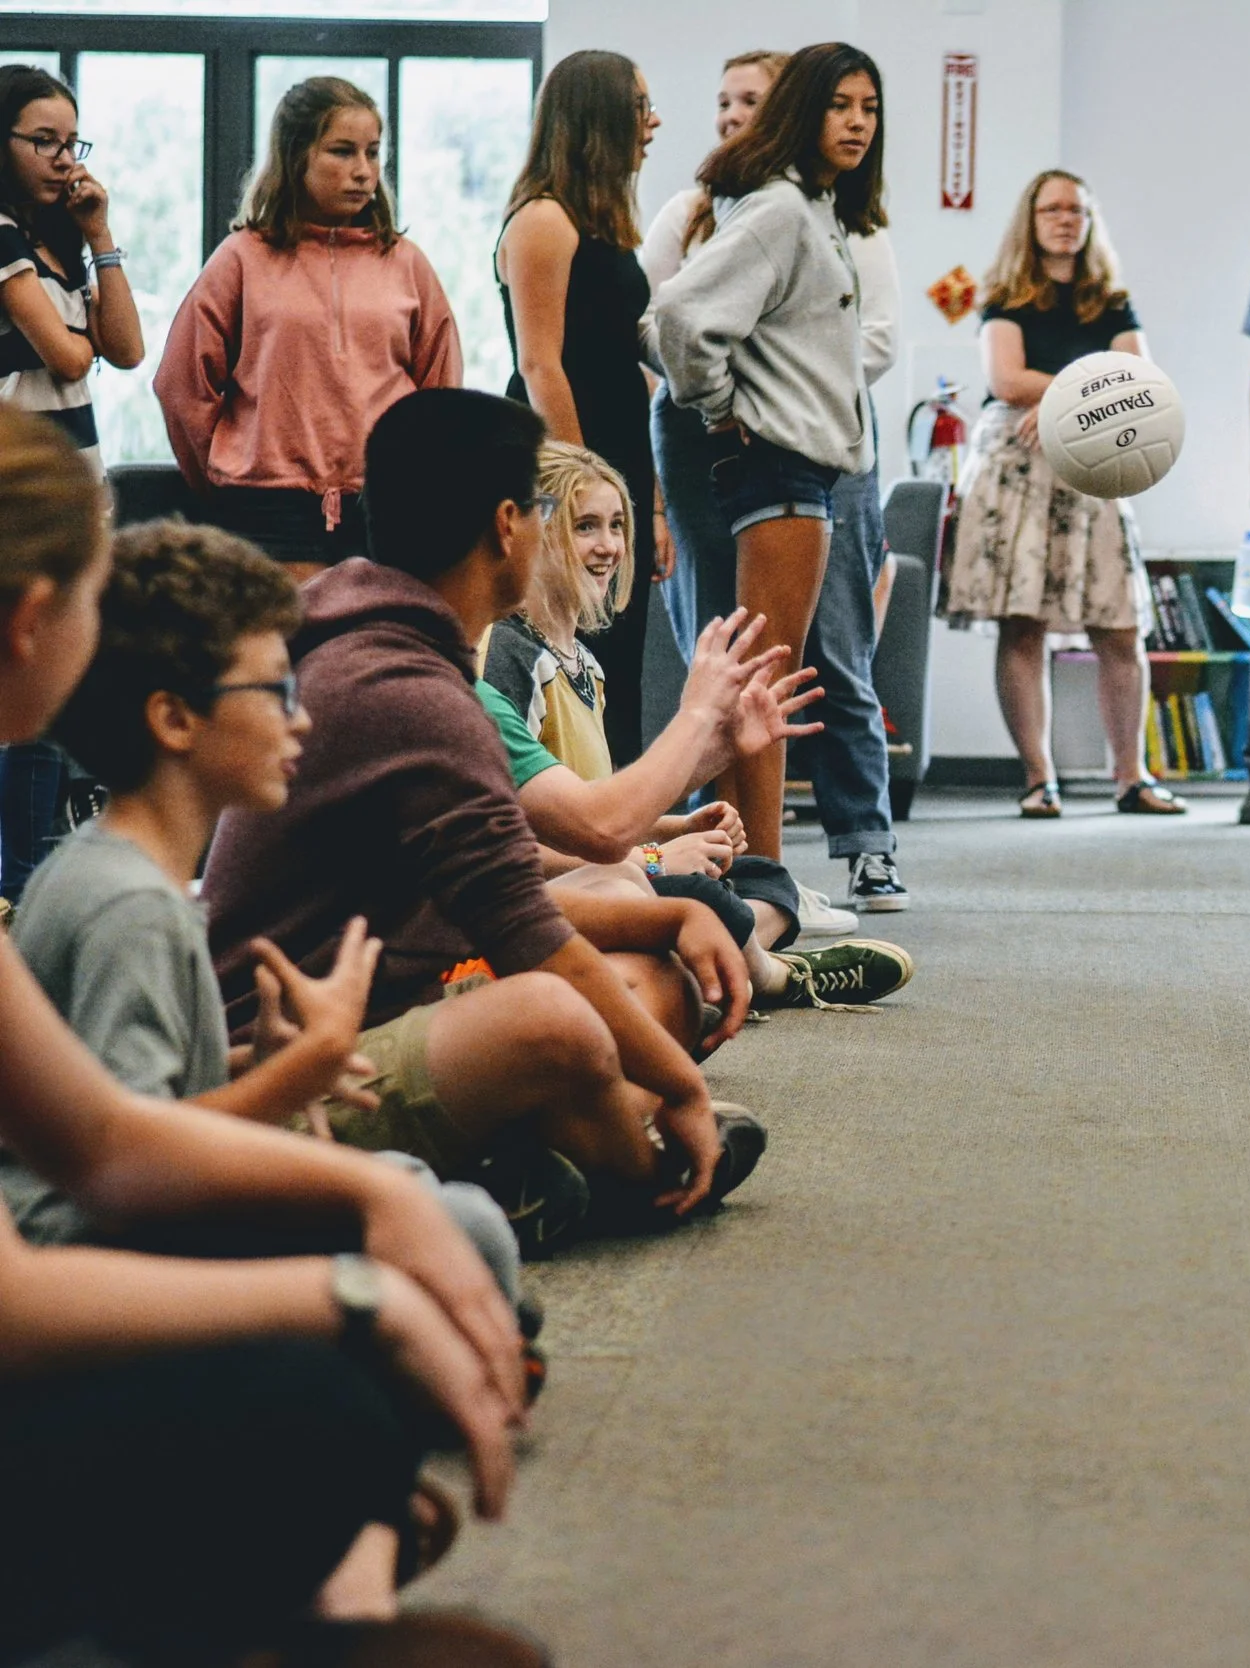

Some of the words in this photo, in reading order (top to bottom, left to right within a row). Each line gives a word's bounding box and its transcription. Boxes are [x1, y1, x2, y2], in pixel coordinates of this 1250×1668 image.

[944, 63, 977, 78] FIRE
[1080, 372, 1136, 398] TF-VB3
[1076, 389, 1155, 432] SPALDING
